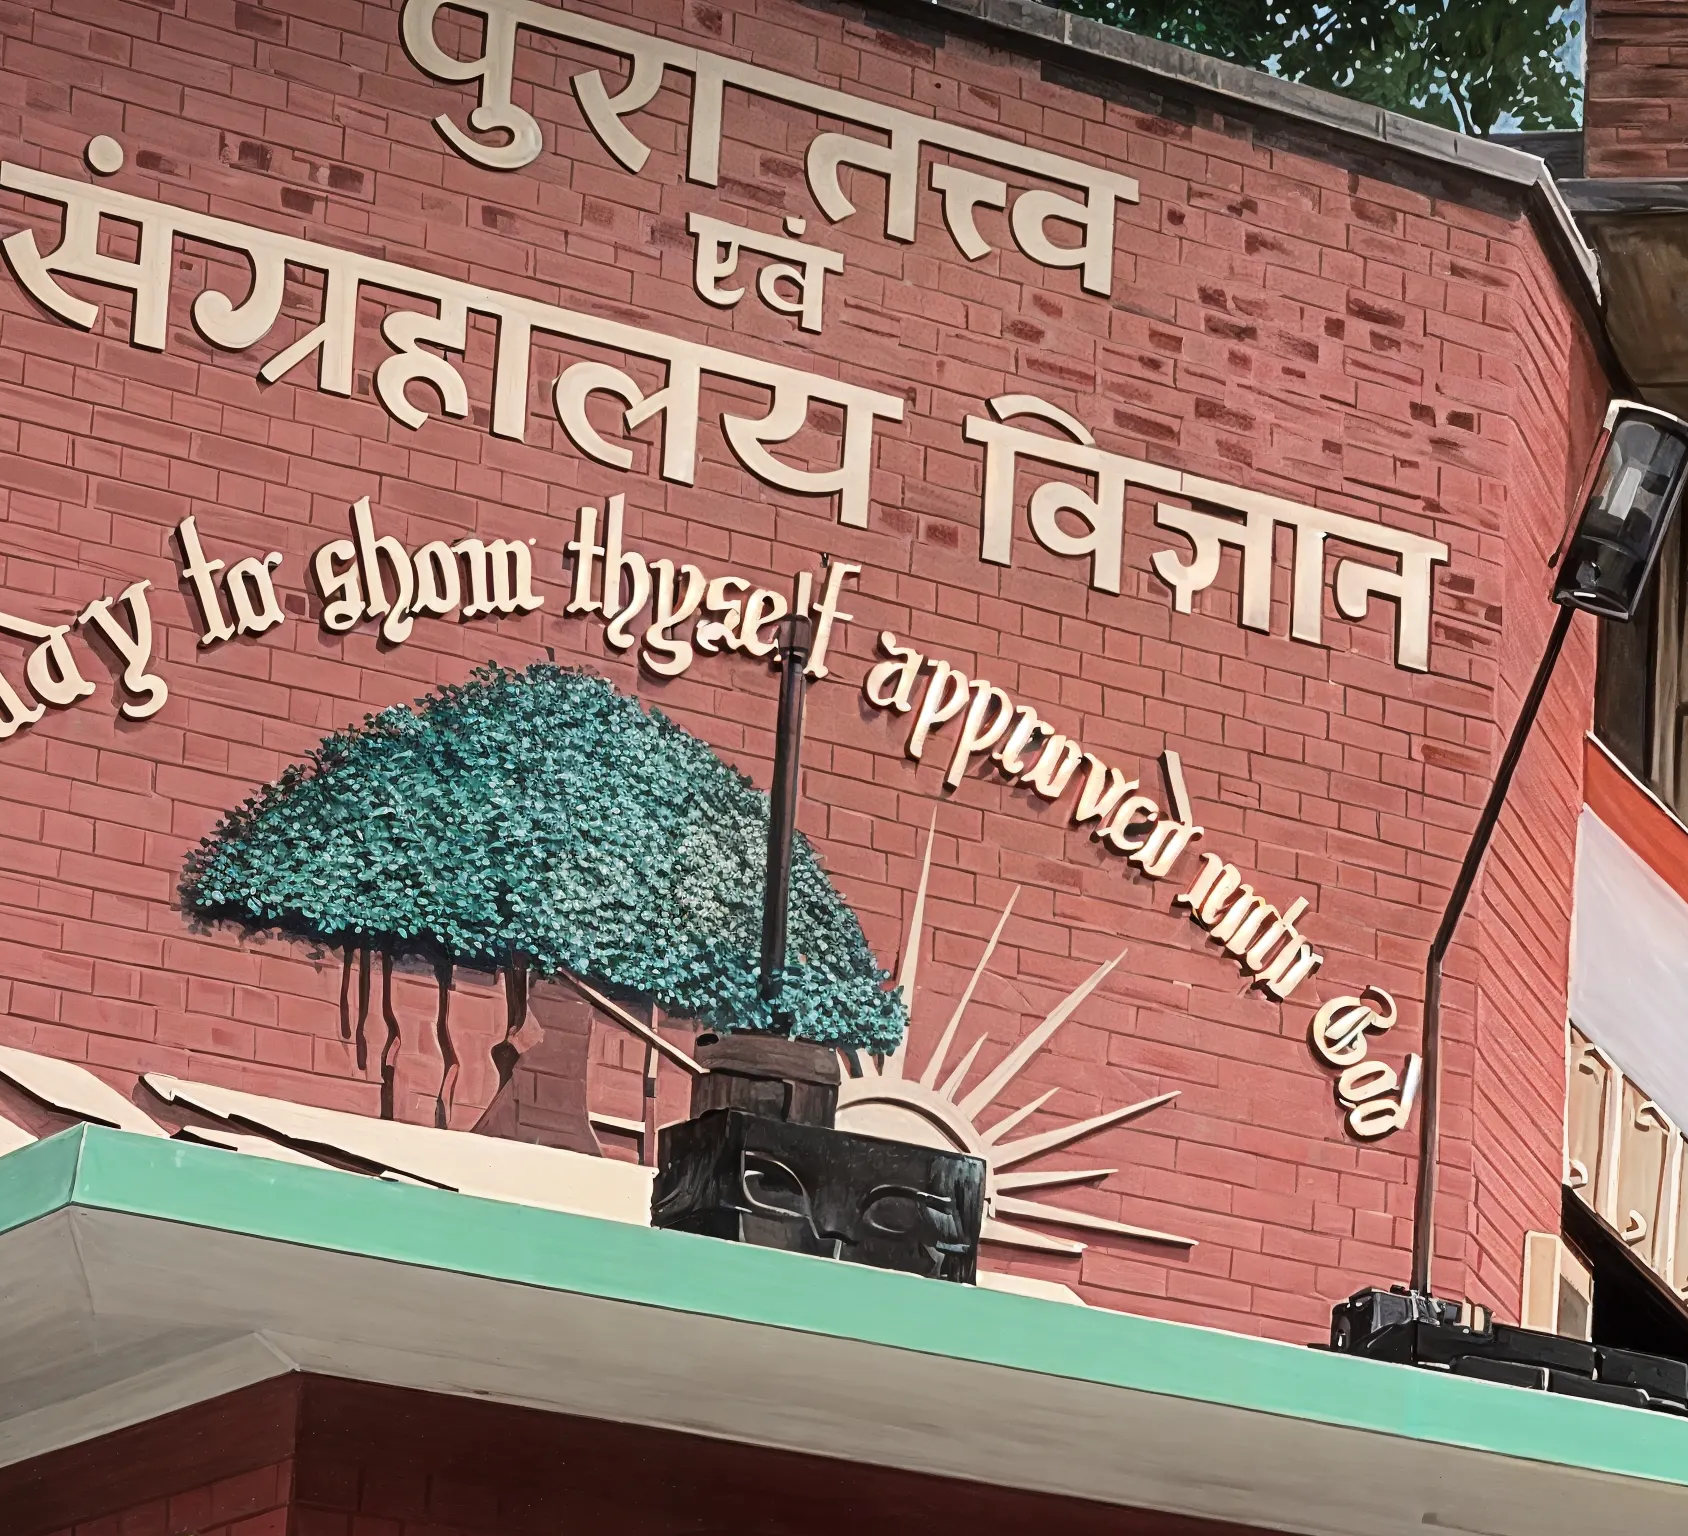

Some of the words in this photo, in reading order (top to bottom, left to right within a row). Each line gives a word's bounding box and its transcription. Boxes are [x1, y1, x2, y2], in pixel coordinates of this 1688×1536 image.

[689, 215, 844, 332] एवं
[962, 393, 1449, 674] विज्ञान
[178, 515, 286, 645] to
[1310, 984, 1423, 1138] God
